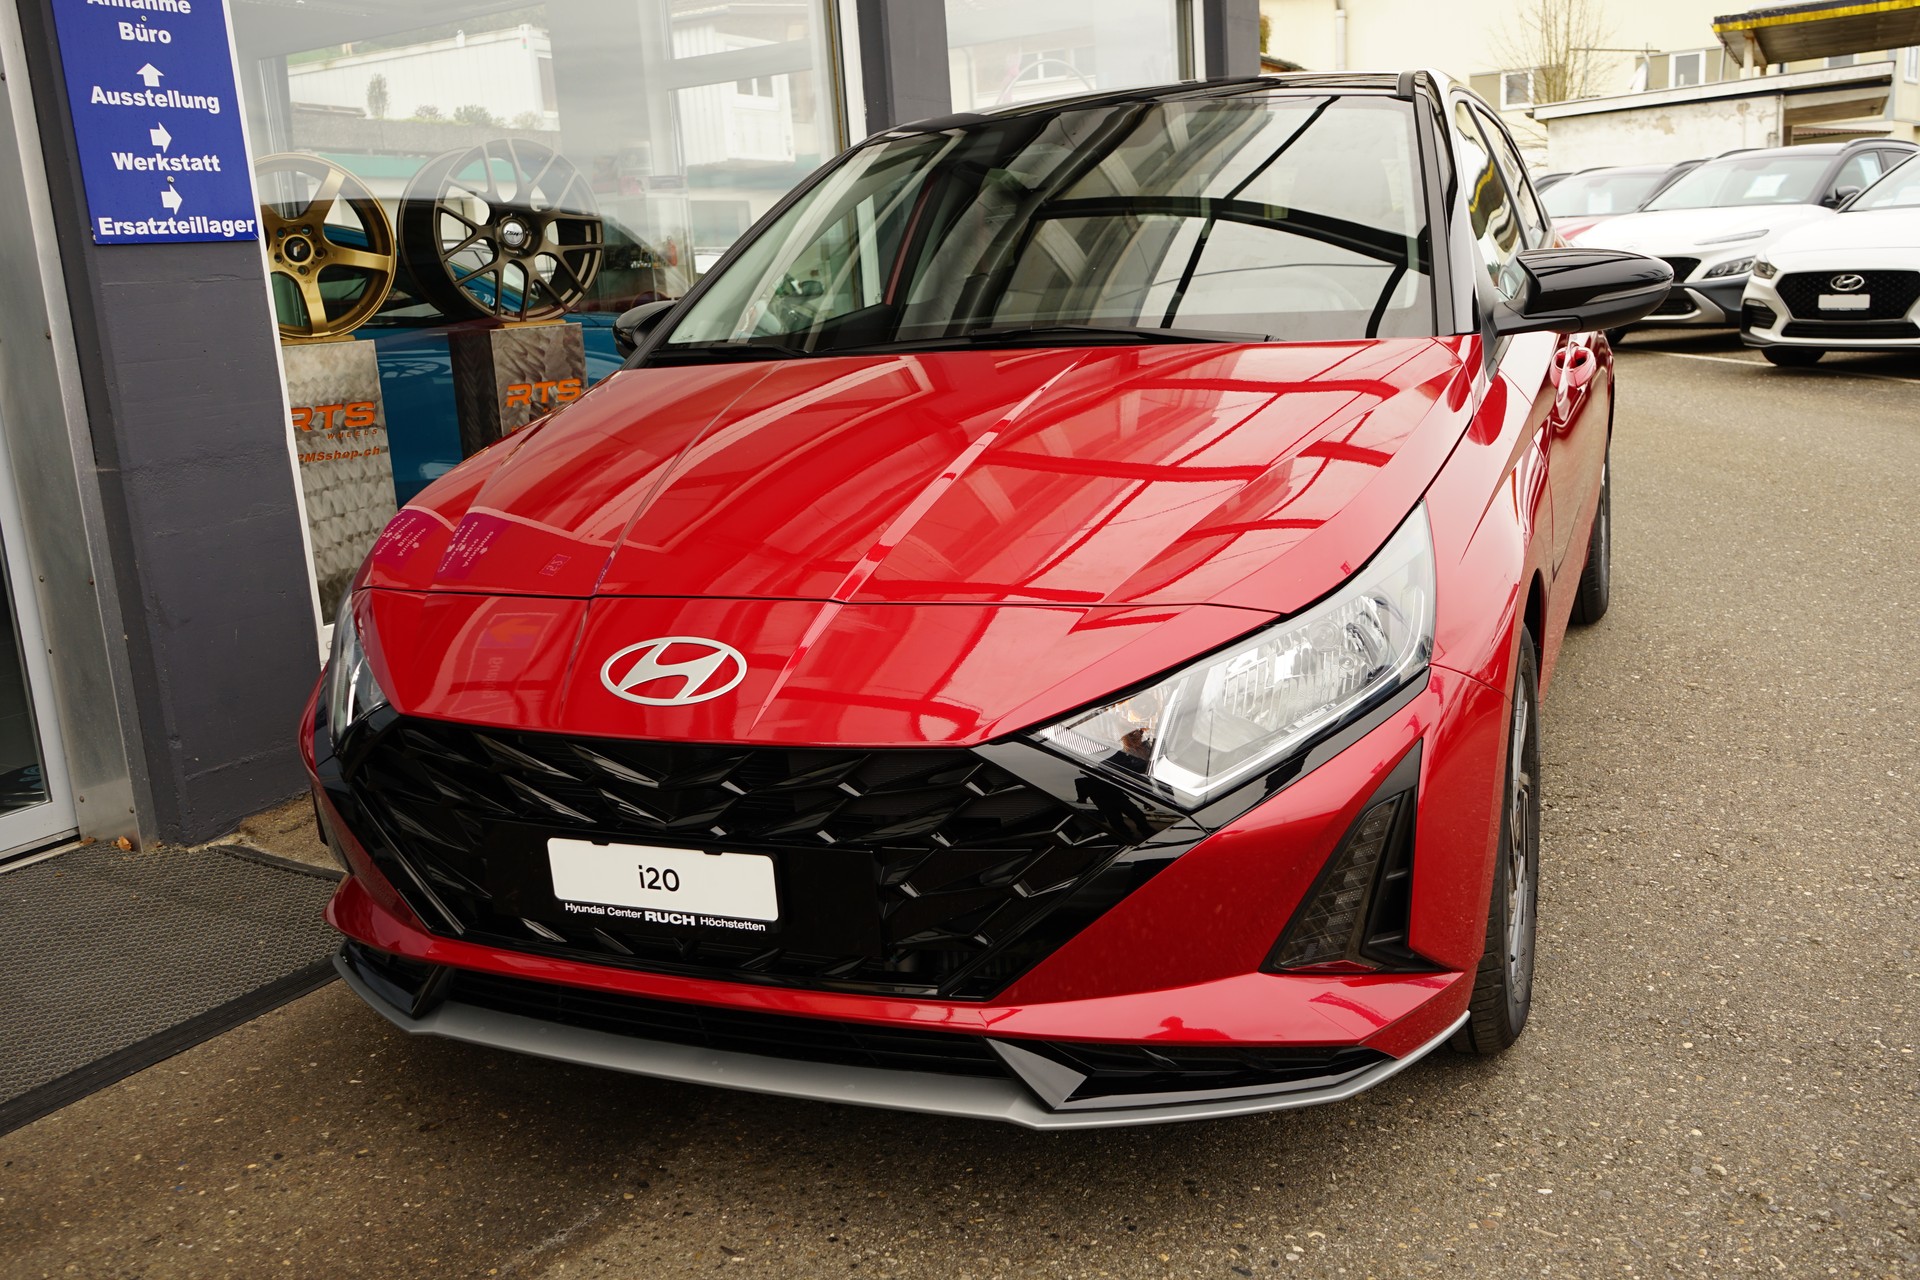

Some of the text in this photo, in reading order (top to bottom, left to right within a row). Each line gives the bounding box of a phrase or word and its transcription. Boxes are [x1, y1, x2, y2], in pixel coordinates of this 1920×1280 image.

[87, 0, 192, 14] nahme
[118, 22, 172, 44] Büro
[91, 86, 220, 114] Ausstellung
[111, 152, 221, 172] Werkstatt
[98, 217, 255, 237] Ersatzteillager
[506, 378, 582, 408] RTS
[291, 401, 375, 432] RTS
[327, 429, 378, 440] WHEELS
[638, 864, 680, 892] i20
[564, 902, 766, 932] Hyundai Center RUCH Höchstetten
